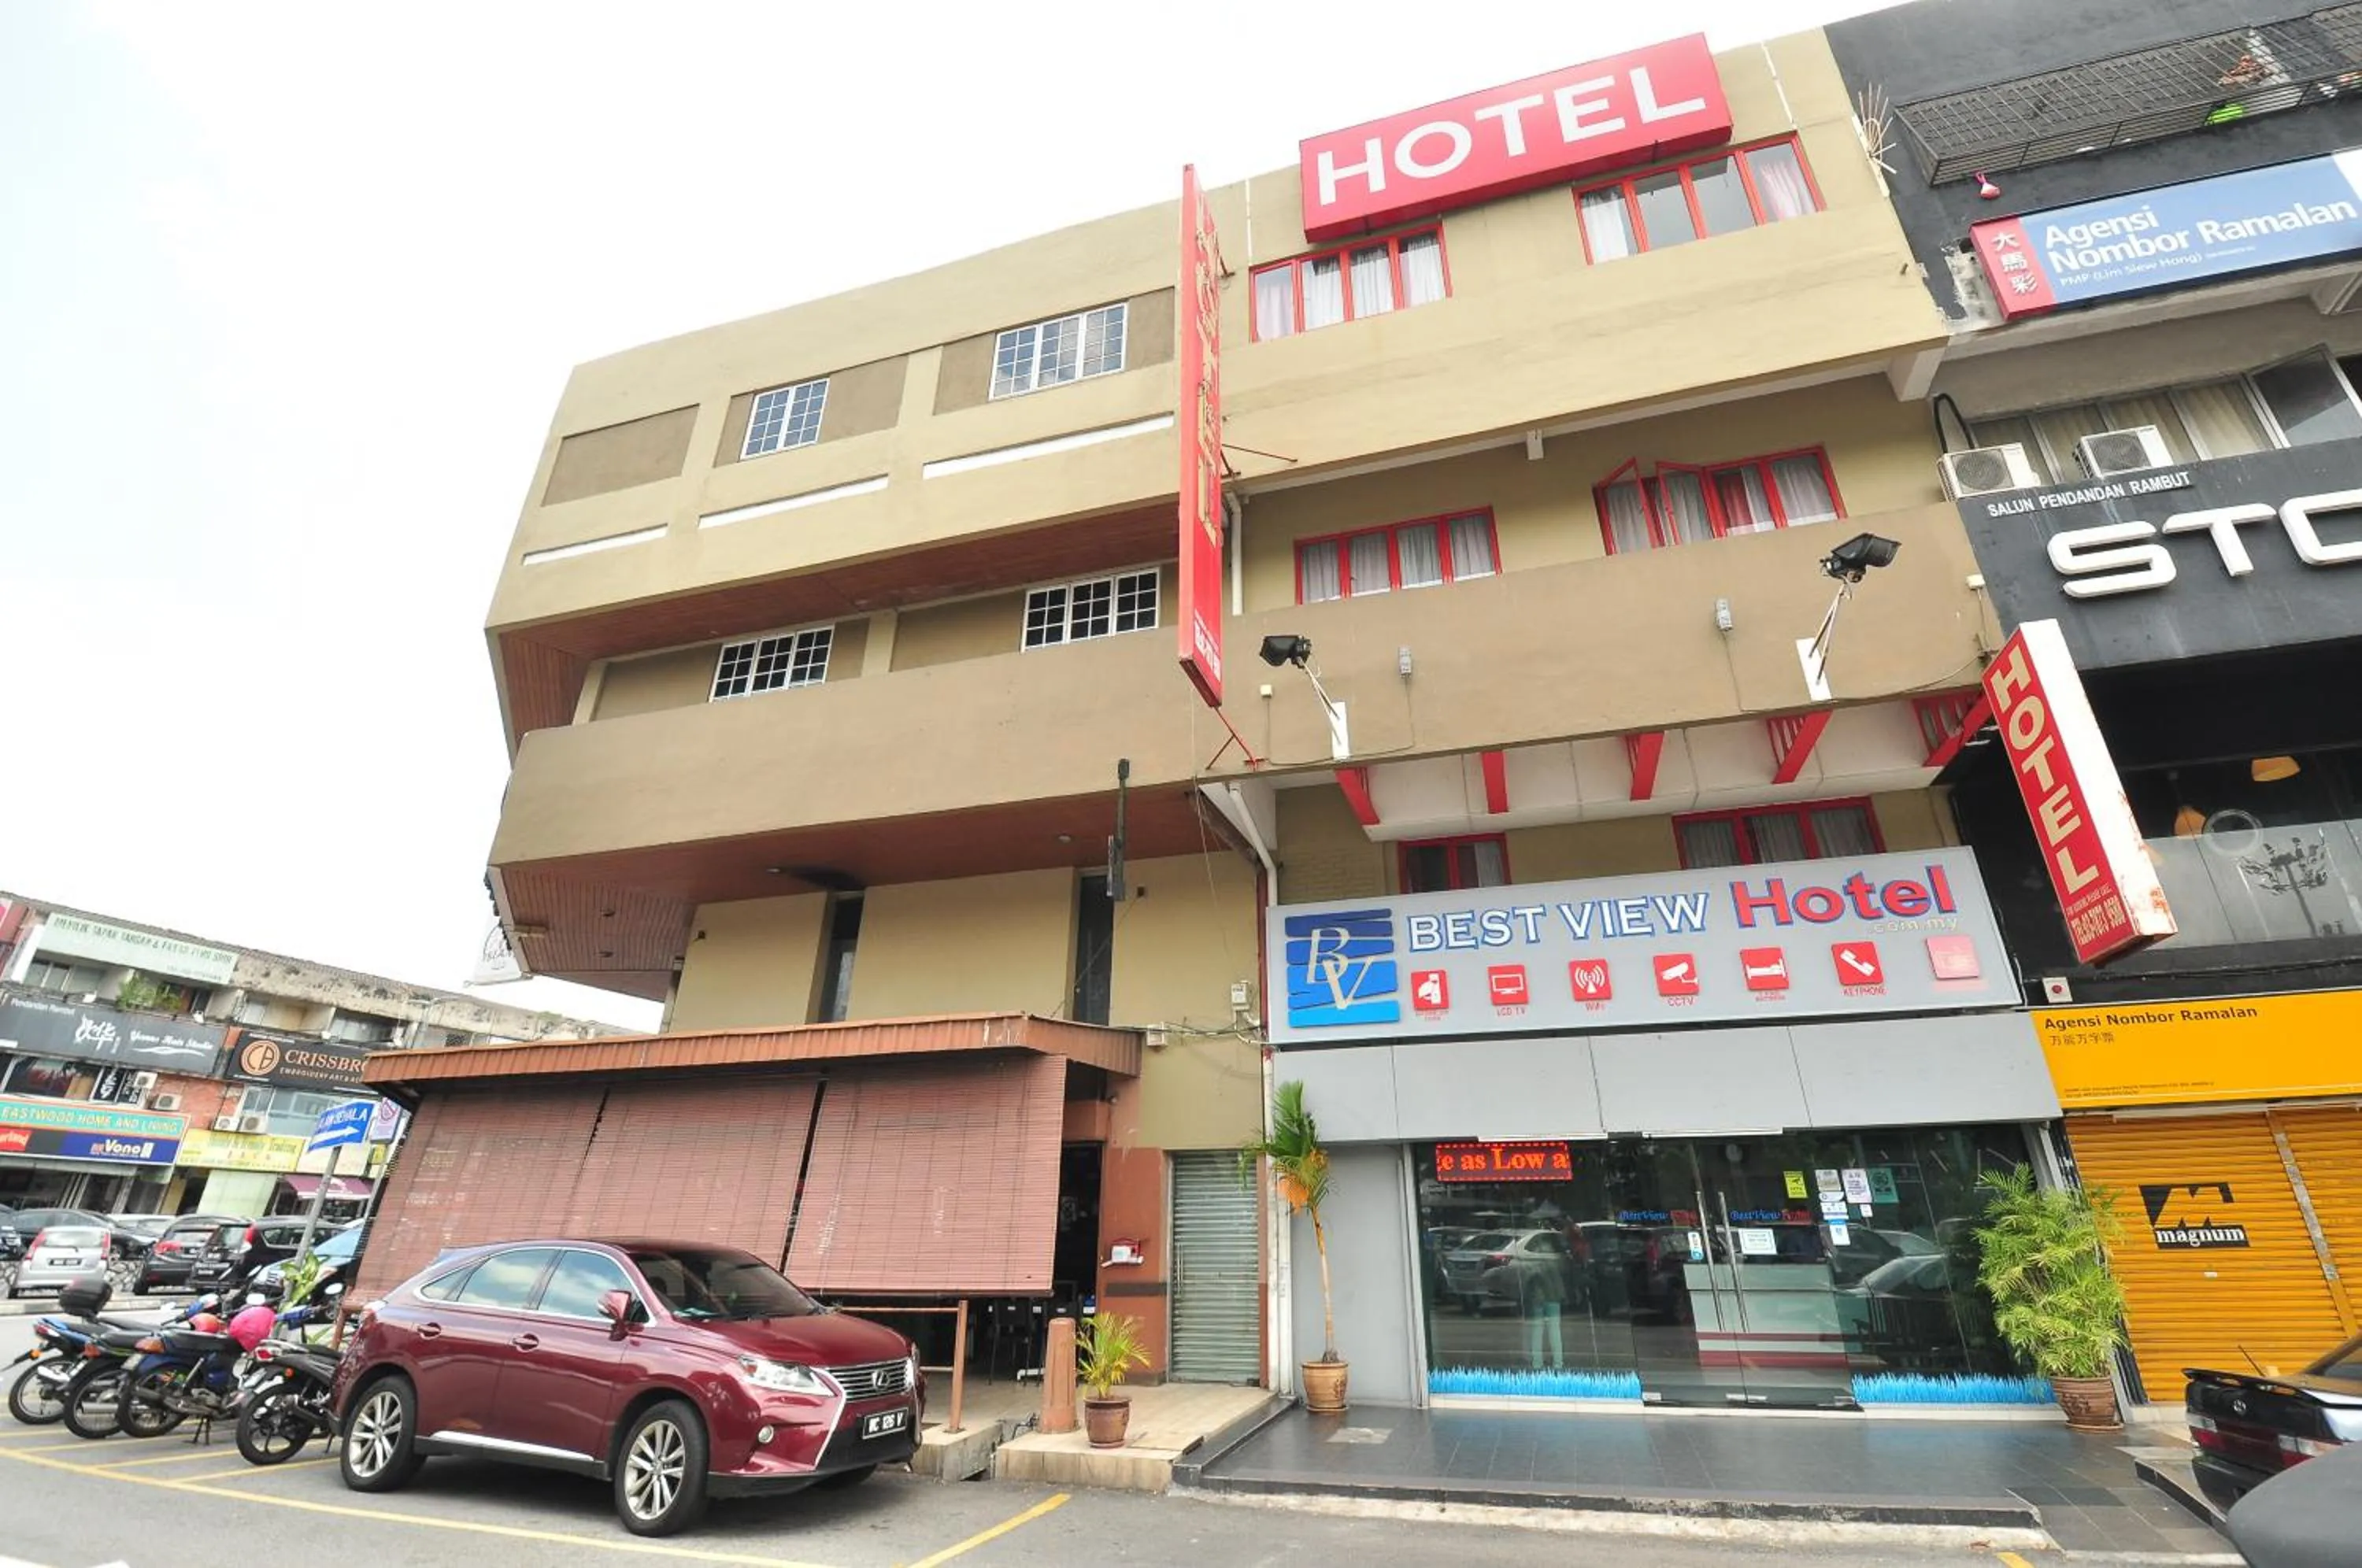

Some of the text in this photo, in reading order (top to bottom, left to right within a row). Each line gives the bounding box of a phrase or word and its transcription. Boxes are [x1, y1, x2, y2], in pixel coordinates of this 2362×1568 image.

[1316, 65, 1706, 206] HOTEL
[2045, 205, 2159, 251] Agensi
[2048, 201, 2358, 275] Nombor Ramalan
[1987, 472, 2192, 518] SALUN PENDANDAN RAMBUT
[1990, 645, 2100, 896] HOTEL
[1406, 865, 1957, 953] BEST VIEW Hotel
[1668, 997, 1694, 1007] CCTV
[2045, 1006, 2258, 1030] Agensi Nombor Ramalan
[77, 1112, 112, 1128] HOME
[106, 1138, 142, 1154] Vono
[1461, 1152, 1486, 1171] as
[1490, 1147, 1546, 1170] Low
[2156, 1226, 2245, 1247] magnum
